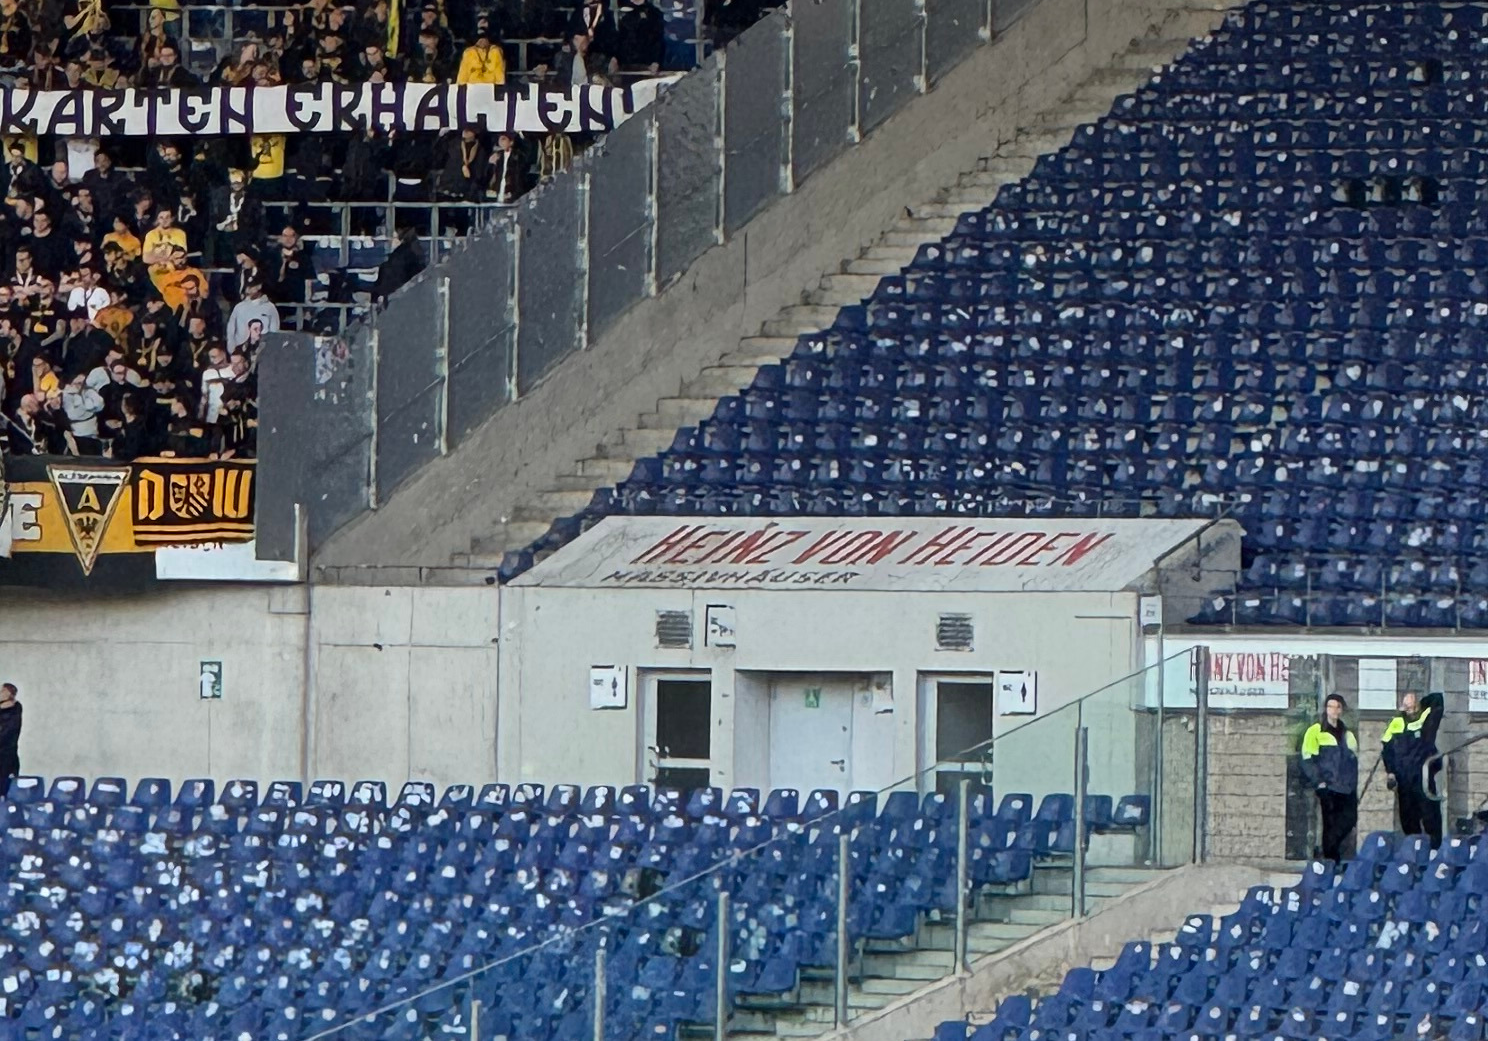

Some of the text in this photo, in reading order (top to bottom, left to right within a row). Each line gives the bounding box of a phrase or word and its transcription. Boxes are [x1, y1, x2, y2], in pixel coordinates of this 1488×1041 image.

[630, 524, 1116, 566] HEINZ VON HEIDEN
[1190, 648, 1232, 682] HNZ
